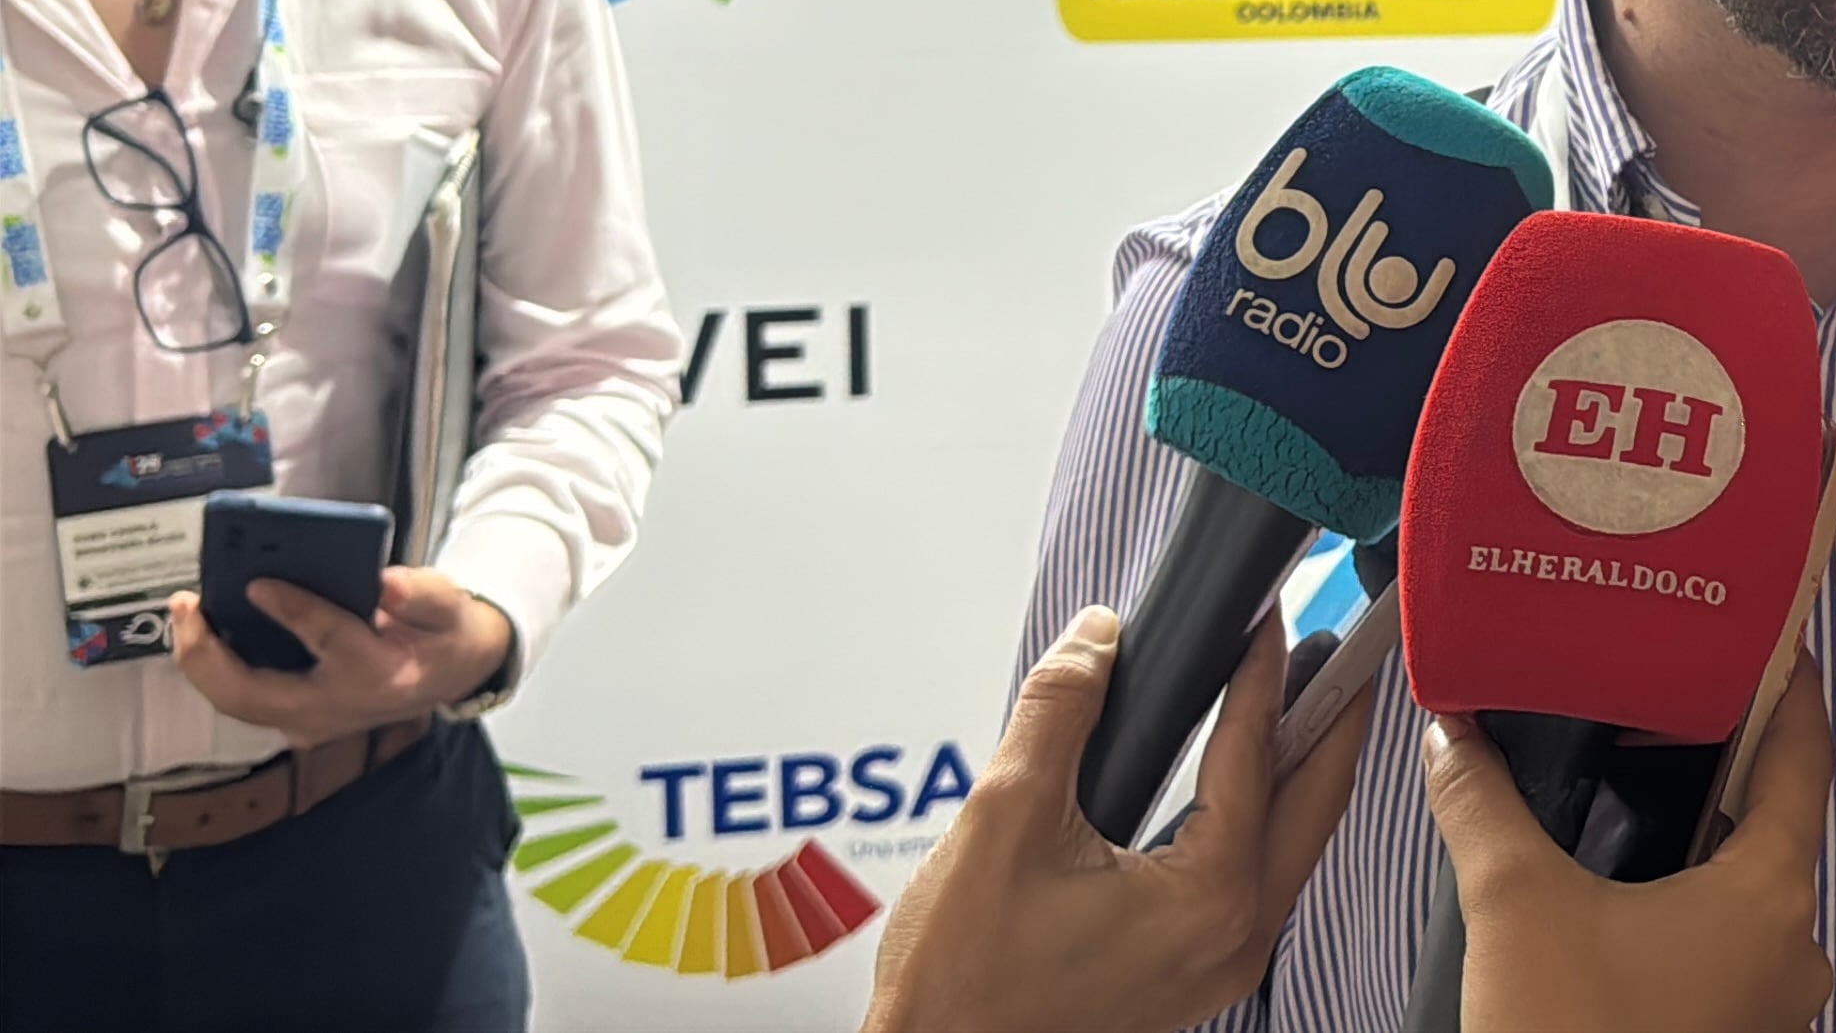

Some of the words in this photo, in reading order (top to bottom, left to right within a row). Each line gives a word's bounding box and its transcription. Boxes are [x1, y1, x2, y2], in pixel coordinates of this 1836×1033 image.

[1236, 147, 1456, 341] blu
[1225, 287, 1348, 370] radio
[1534, 378, 1723, 479] EH
[1467, 545, 1727, 607] ELHERALDO.CO
[640, 741, 976, 839] TEBSA
